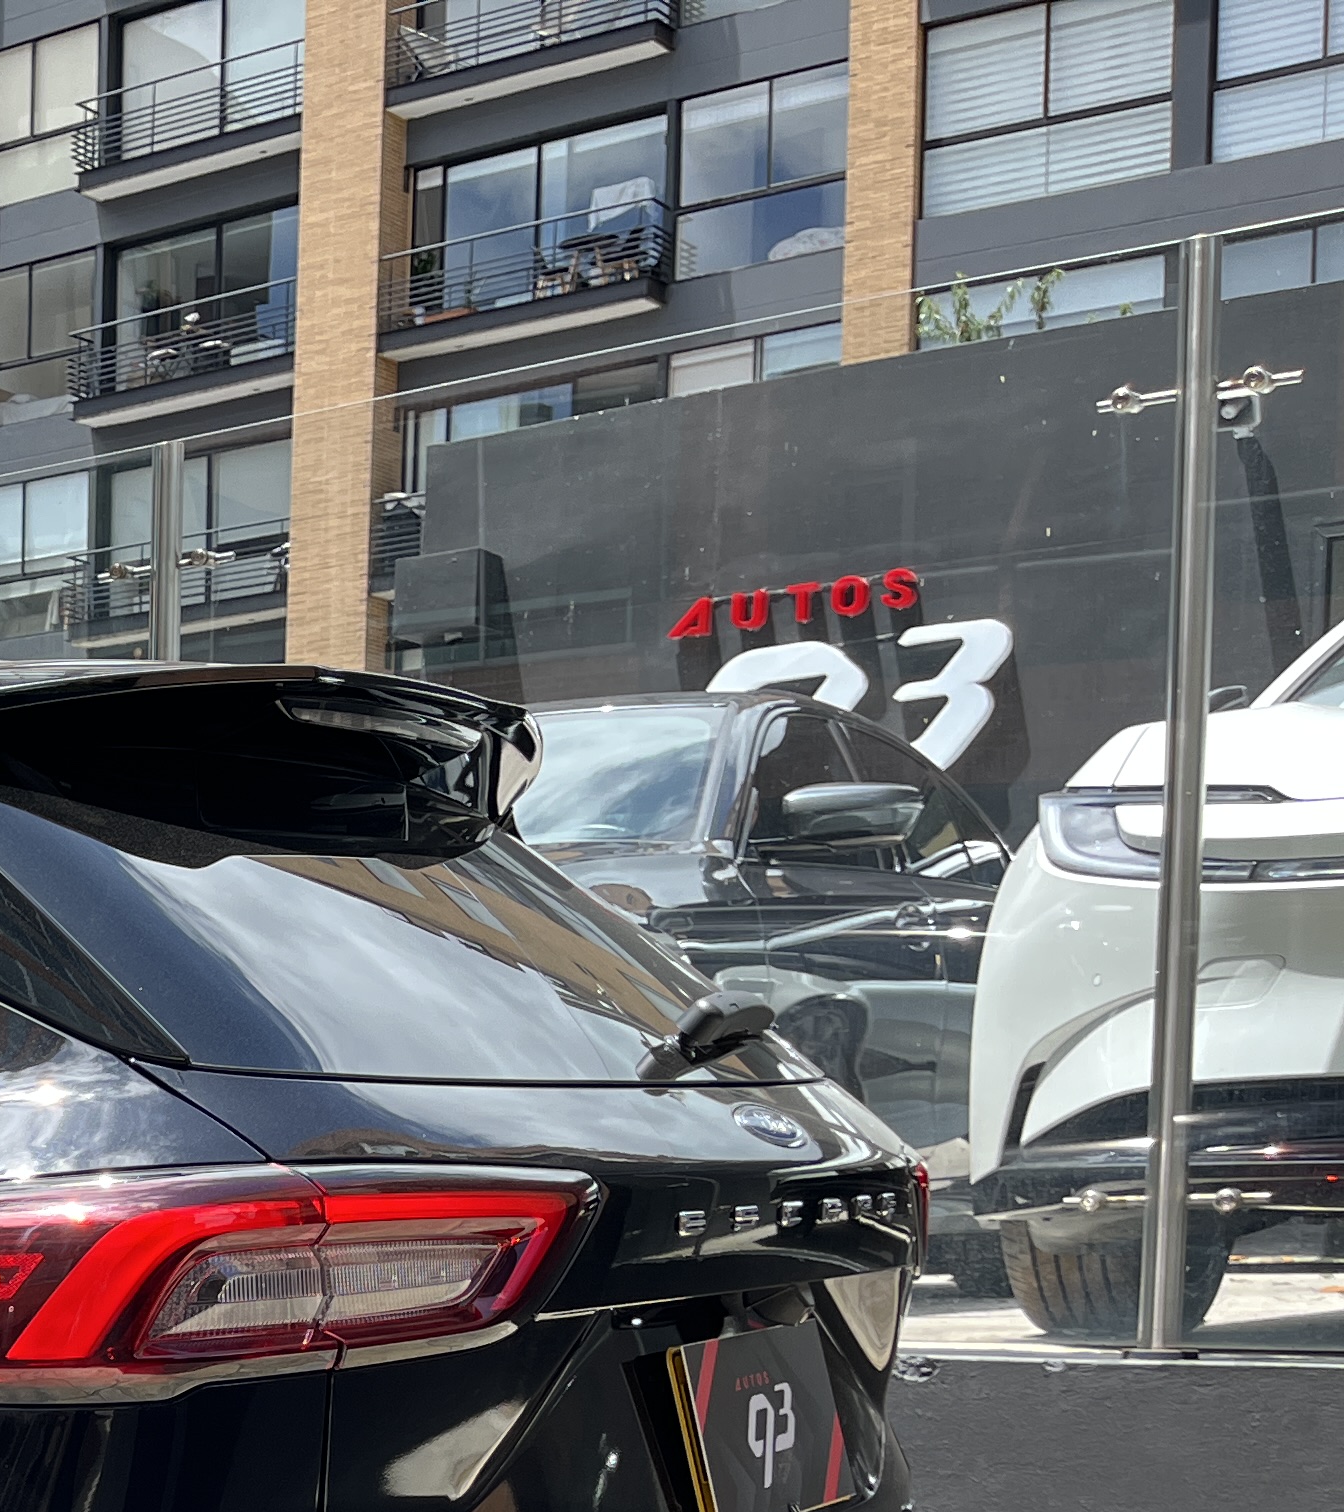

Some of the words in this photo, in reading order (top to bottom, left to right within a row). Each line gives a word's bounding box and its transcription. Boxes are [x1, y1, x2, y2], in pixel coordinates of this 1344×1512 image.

[667, 567, 919, 640] AUTOS
[735, 1371, 770, 1392] AUTOS
[747, 1382, 796, 1489] 93
